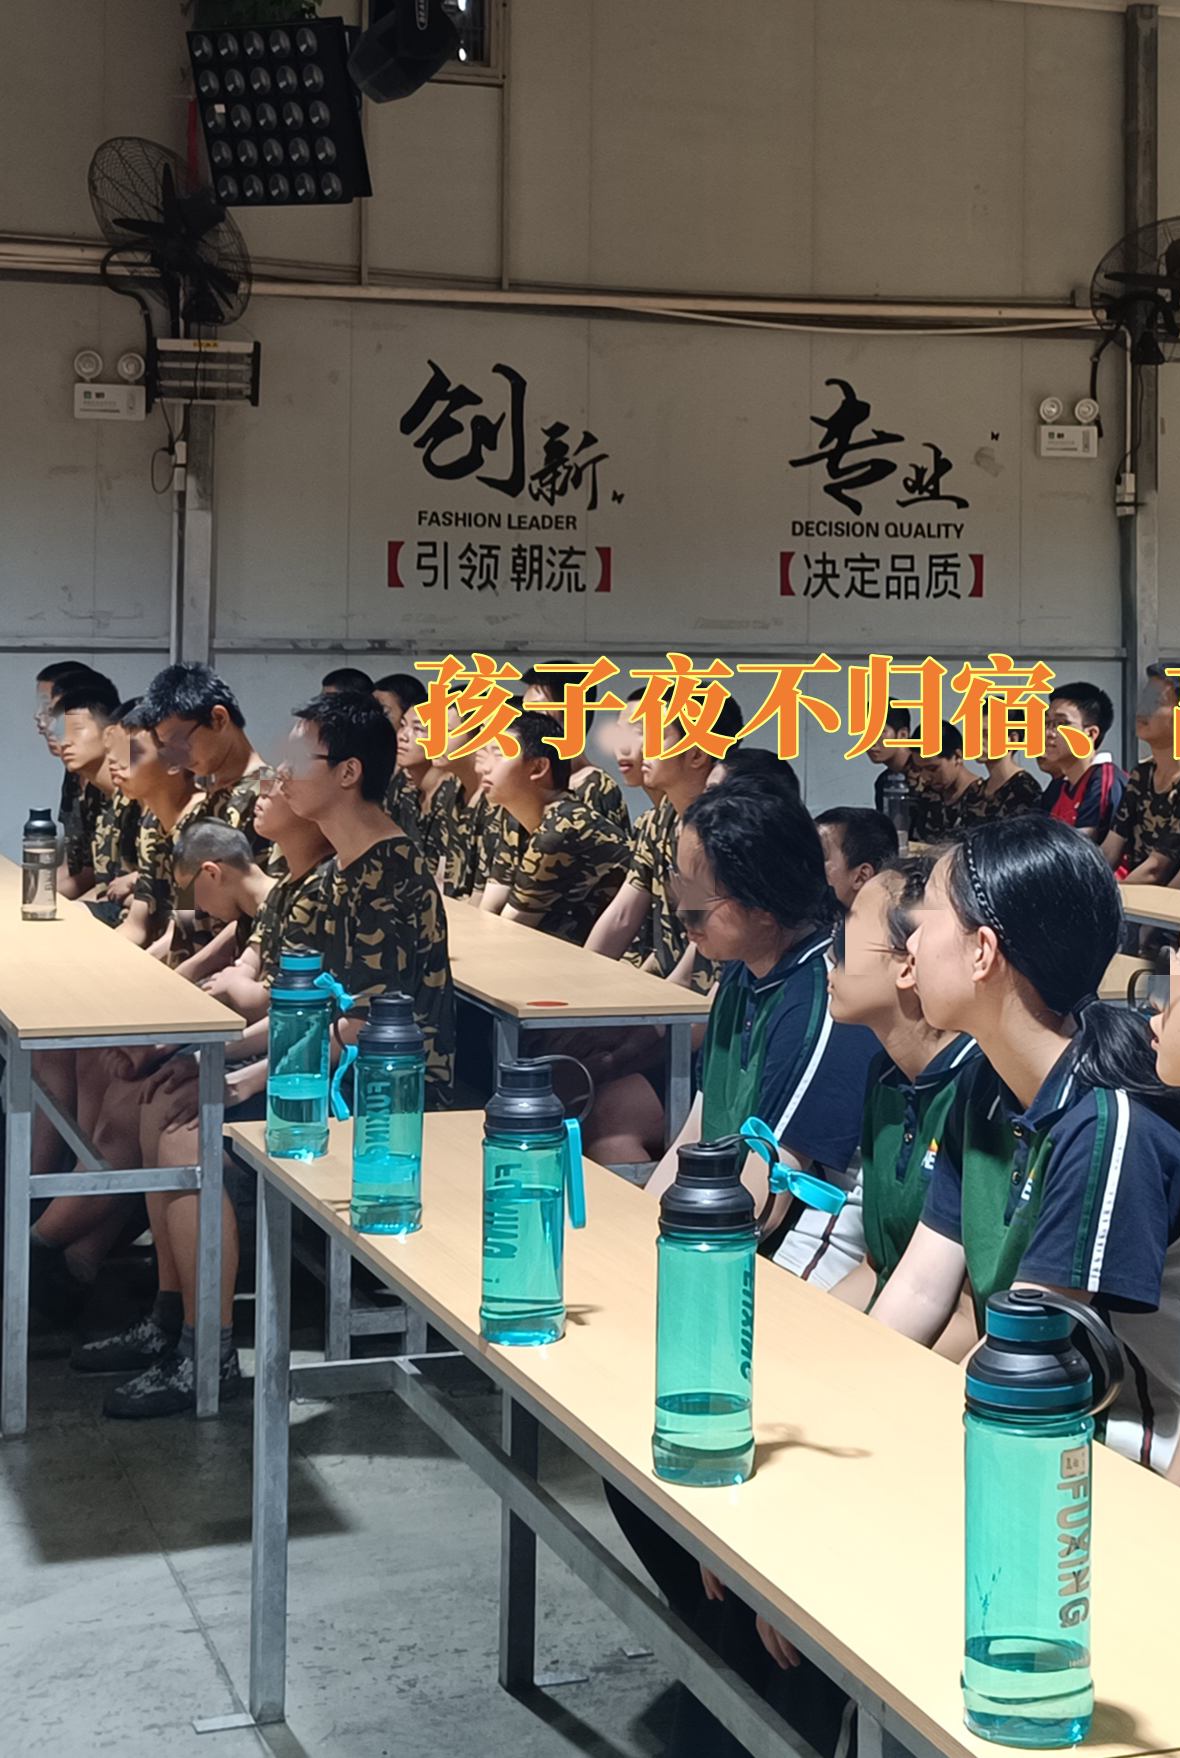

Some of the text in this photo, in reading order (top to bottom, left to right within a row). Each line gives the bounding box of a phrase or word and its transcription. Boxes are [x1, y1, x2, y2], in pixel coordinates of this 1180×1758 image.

[400, 359, 610, 511] 创新
[788, 378, 970, 516] 专业
[417, 510, 578, 531] FASHION LEADER
[791, 520, 965, 539] DECISION QUALITY
[1056, 1476, 1093, 1629] FUXING
